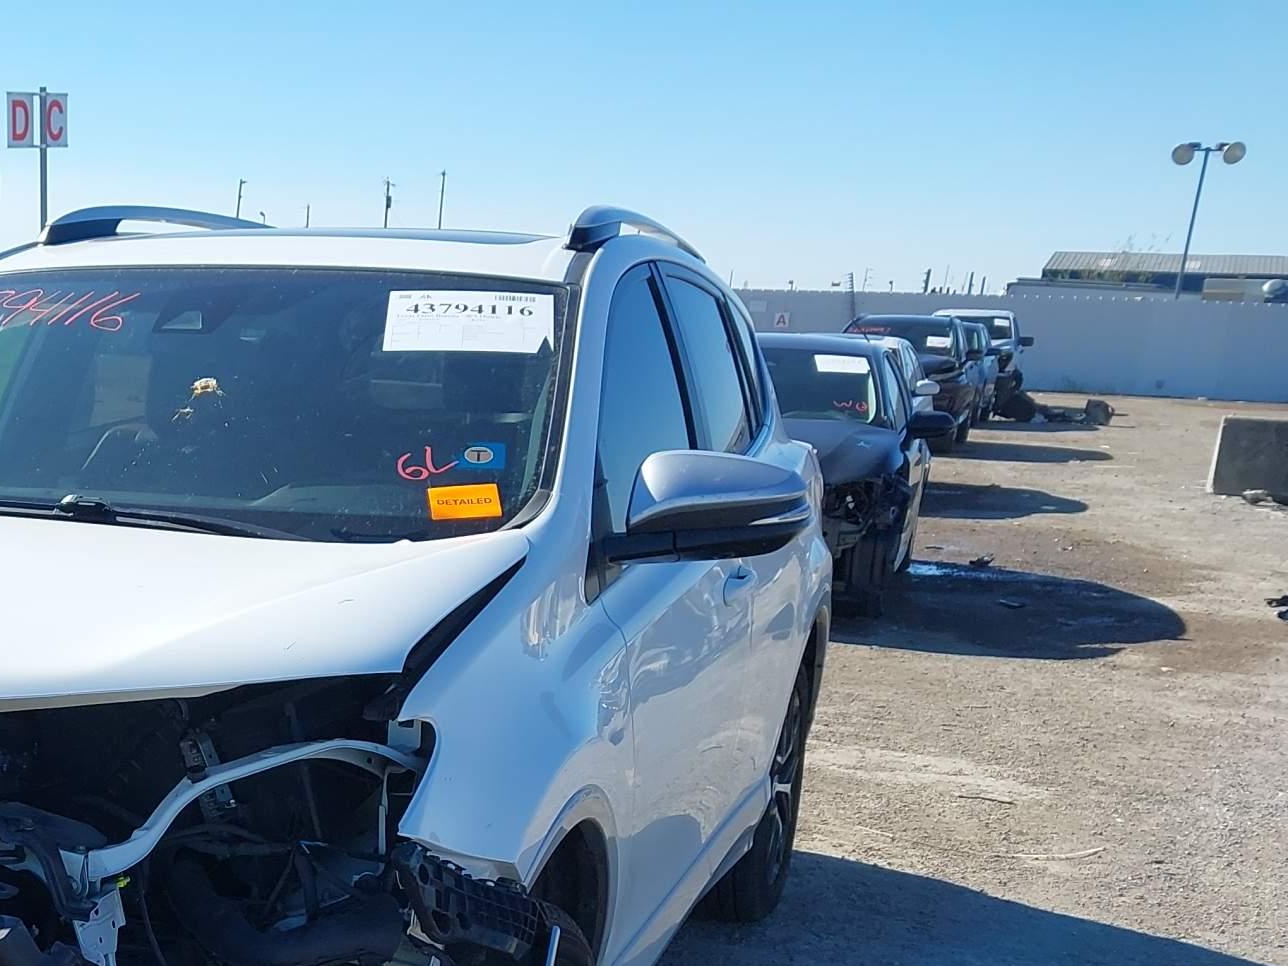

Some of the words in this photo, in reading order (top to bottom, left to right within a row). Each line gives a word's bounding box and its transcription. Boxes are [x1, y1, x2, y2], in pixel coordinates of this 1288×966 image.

[11, 99, 29, 141] D
[47, 99, 64, 141] C
[406, 303, 533, 316] 43794116
[776, 315, 786, 325] A
[436, 496, 493, 506] DETAILED
